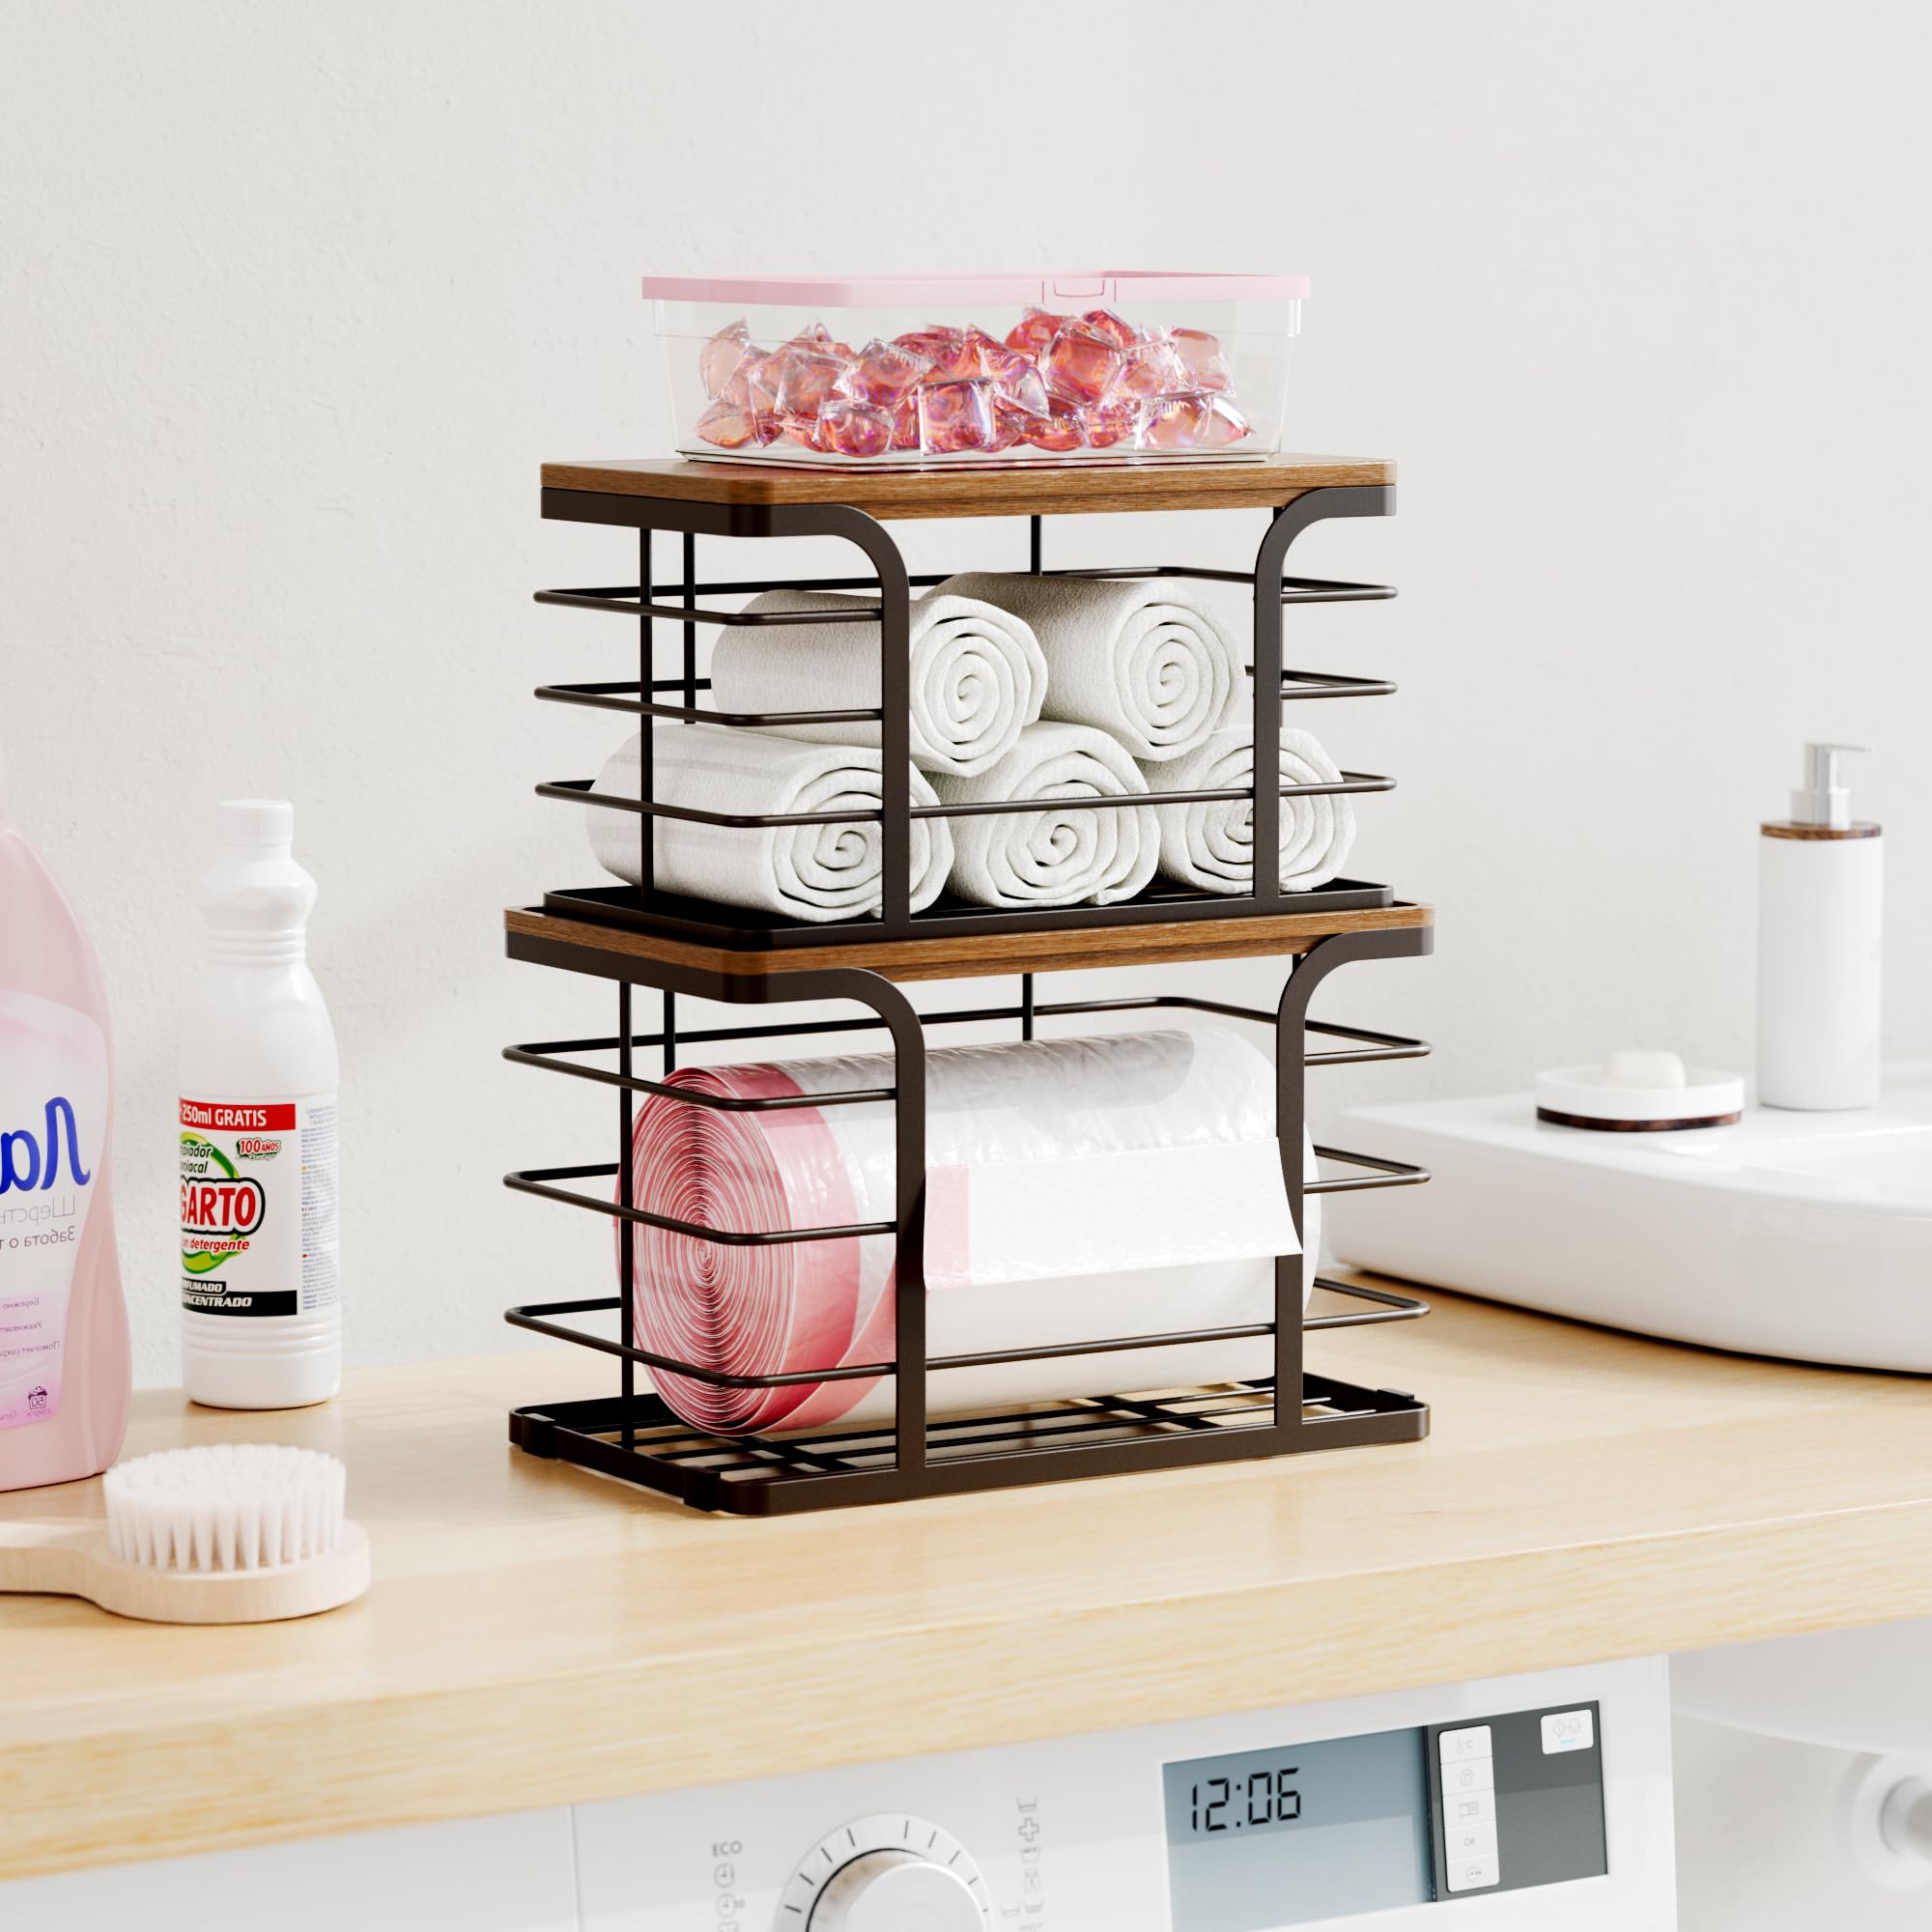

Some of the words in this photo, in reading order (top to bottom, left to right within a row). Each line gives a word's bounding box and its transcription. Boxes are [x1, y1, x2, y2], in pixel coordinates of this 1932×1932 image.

[214, 1108, 268, 1127] GRATIS
[241, 1140, 261, 1153] 100
[181, 1183, 256, 1227] GARTO
[190, 1237, 250, 1253] detergente
[1192, 1767, 1301, 1832] 12:06
[712, 1839, 743, 1858] ECO
